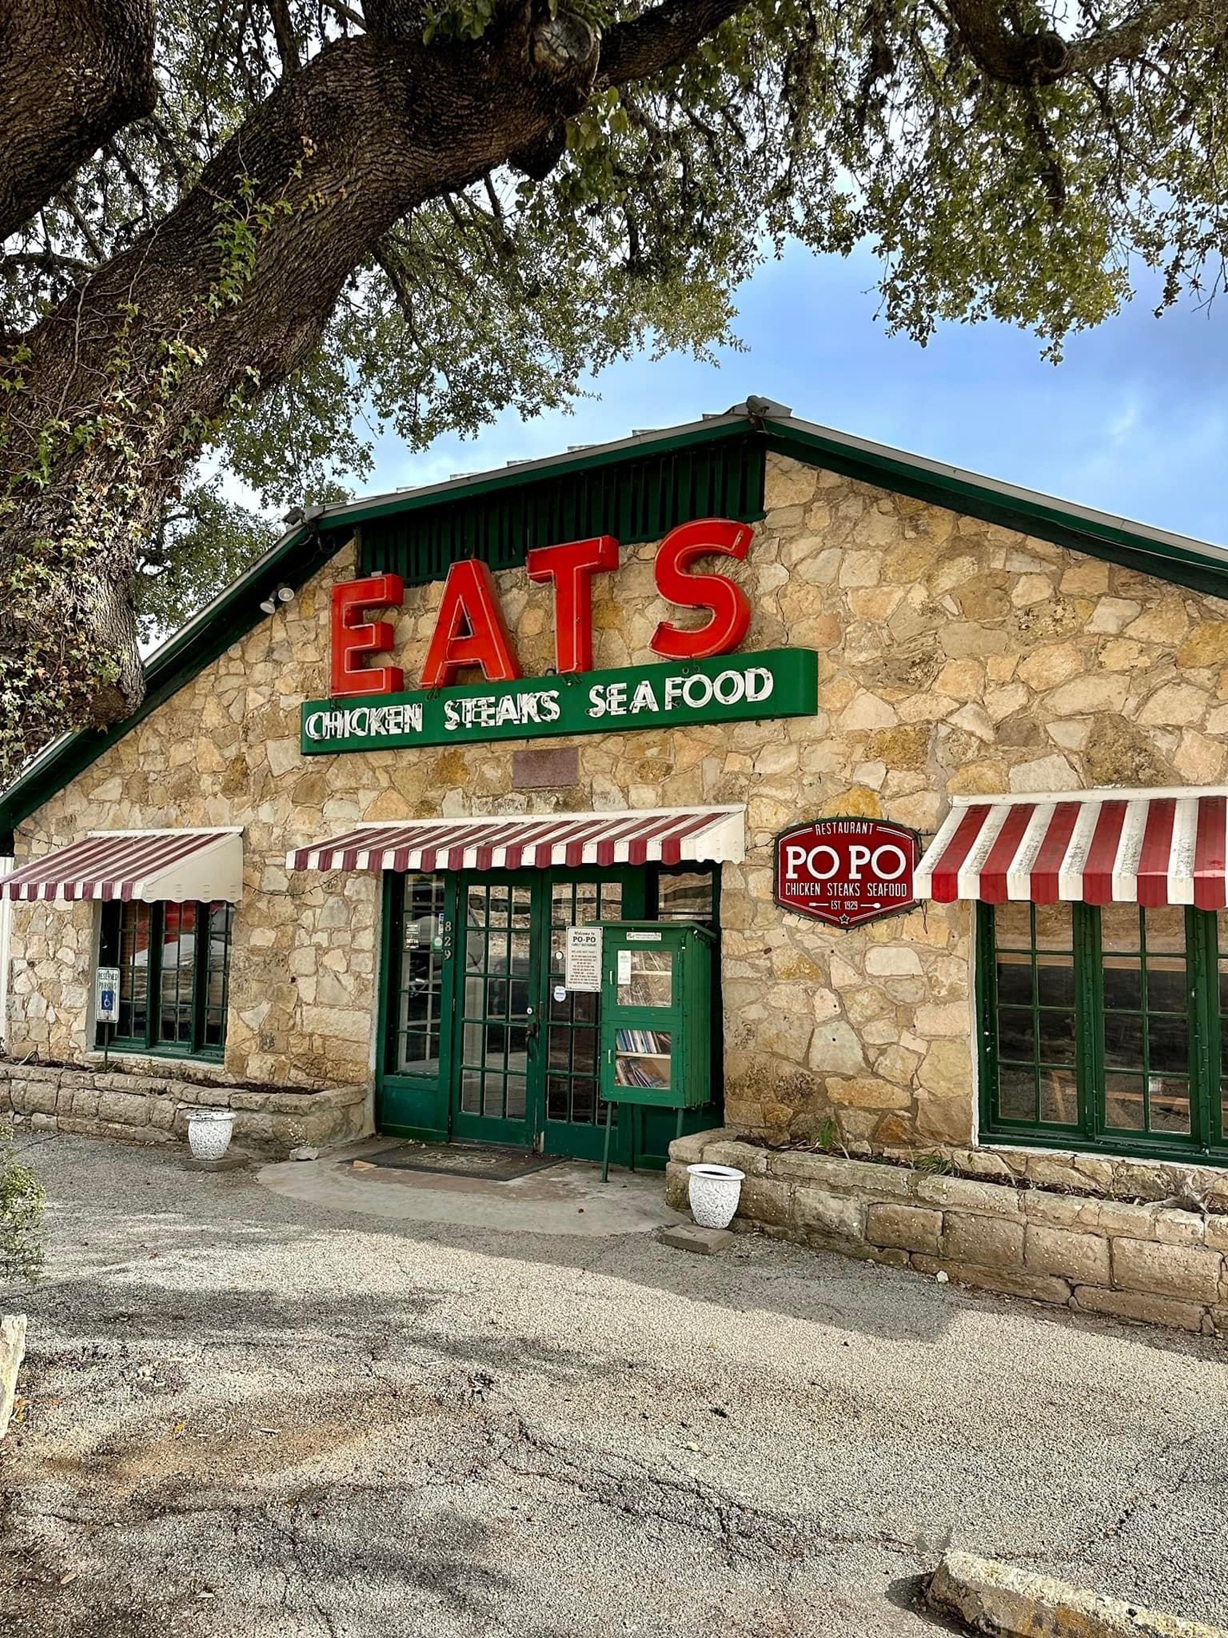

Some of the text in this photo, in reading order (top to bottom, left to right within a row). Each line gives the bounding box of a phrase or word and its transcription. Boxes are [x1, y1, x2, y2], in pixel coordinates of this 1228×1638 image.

[331, 518, 754, 698] EATS
[305, 667, 774, 741] CHICKEN STEAKS SEAFOOD
[815, 822, 874, 836] RESTAURANT
[785, 844, 907, 880] PO PO
[785, 882, 907, 897] CHICKEN STEAKS SEAFOOD
[830, 901, 858, 910] EST. 1929
